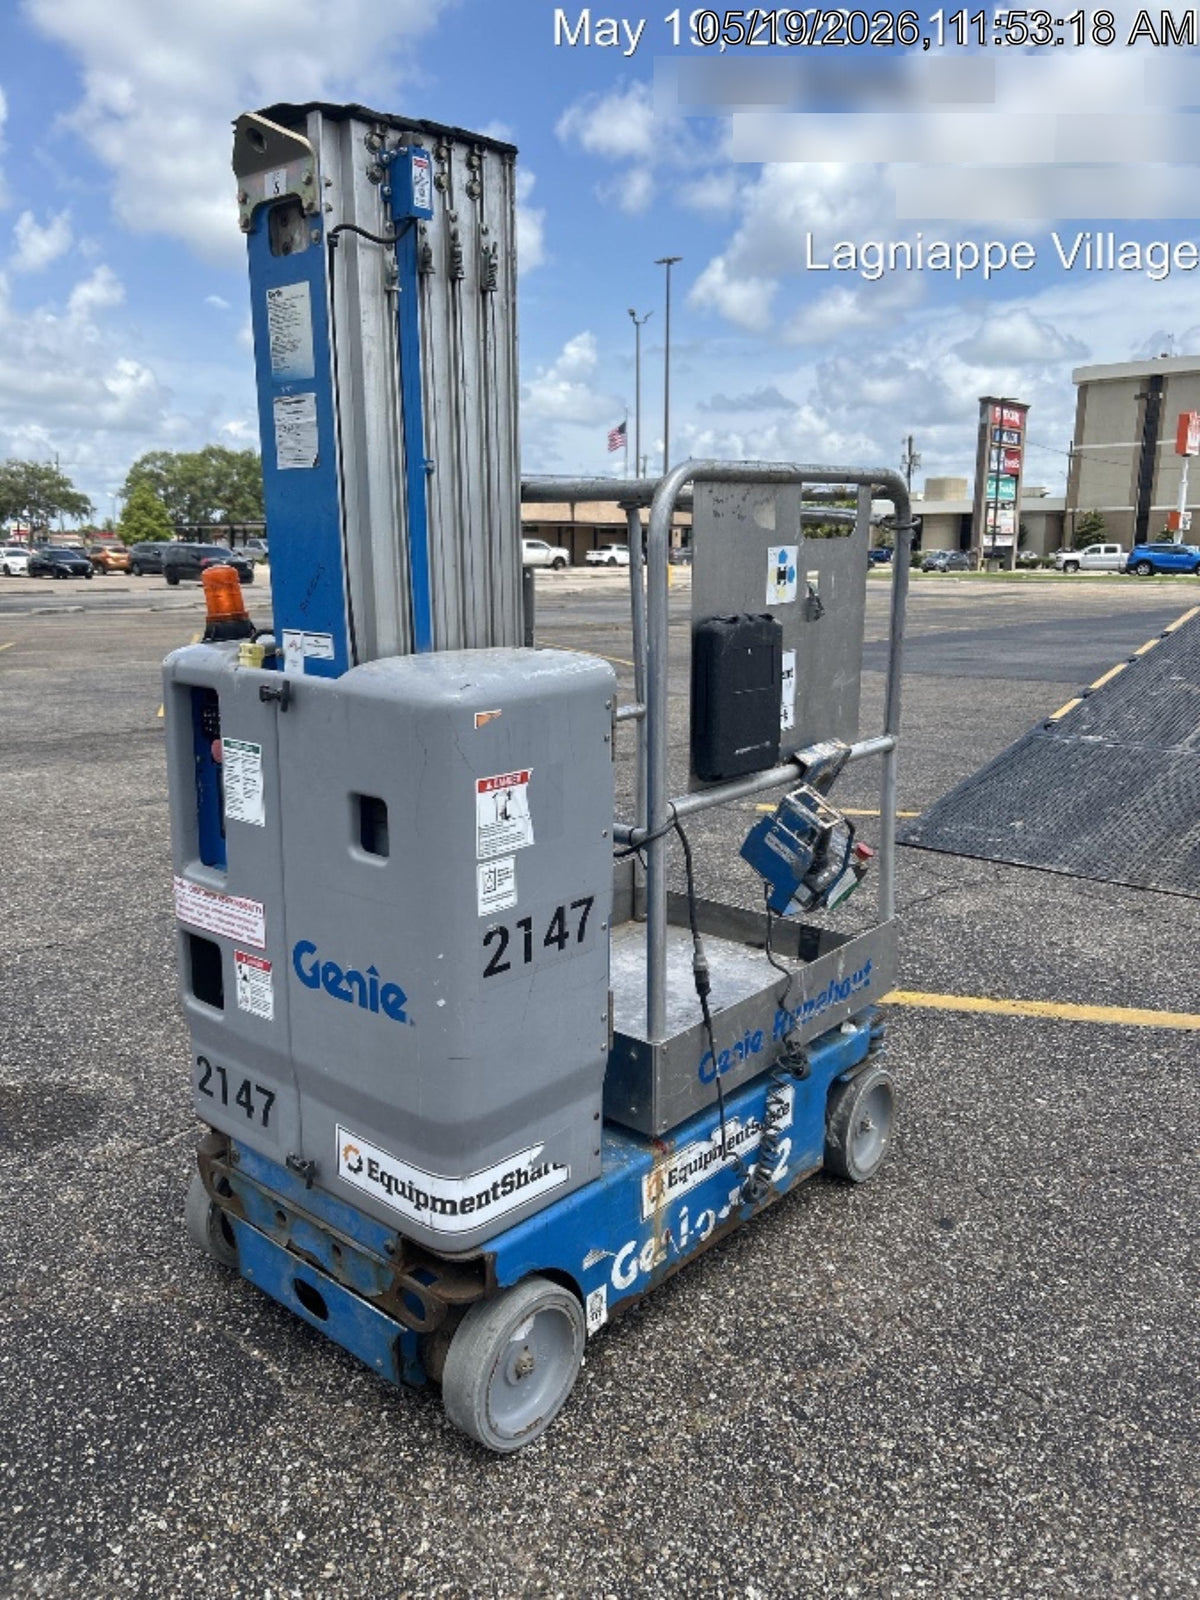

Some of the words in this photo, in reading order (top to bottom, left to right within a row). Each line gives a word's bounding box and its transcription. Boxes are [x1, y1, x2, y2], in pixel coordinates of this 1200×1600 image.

[483, 895, 595, 979] 2147
[293, 939, 408, 1025] Genie
[196, 1055, 276, 1128] 2147
